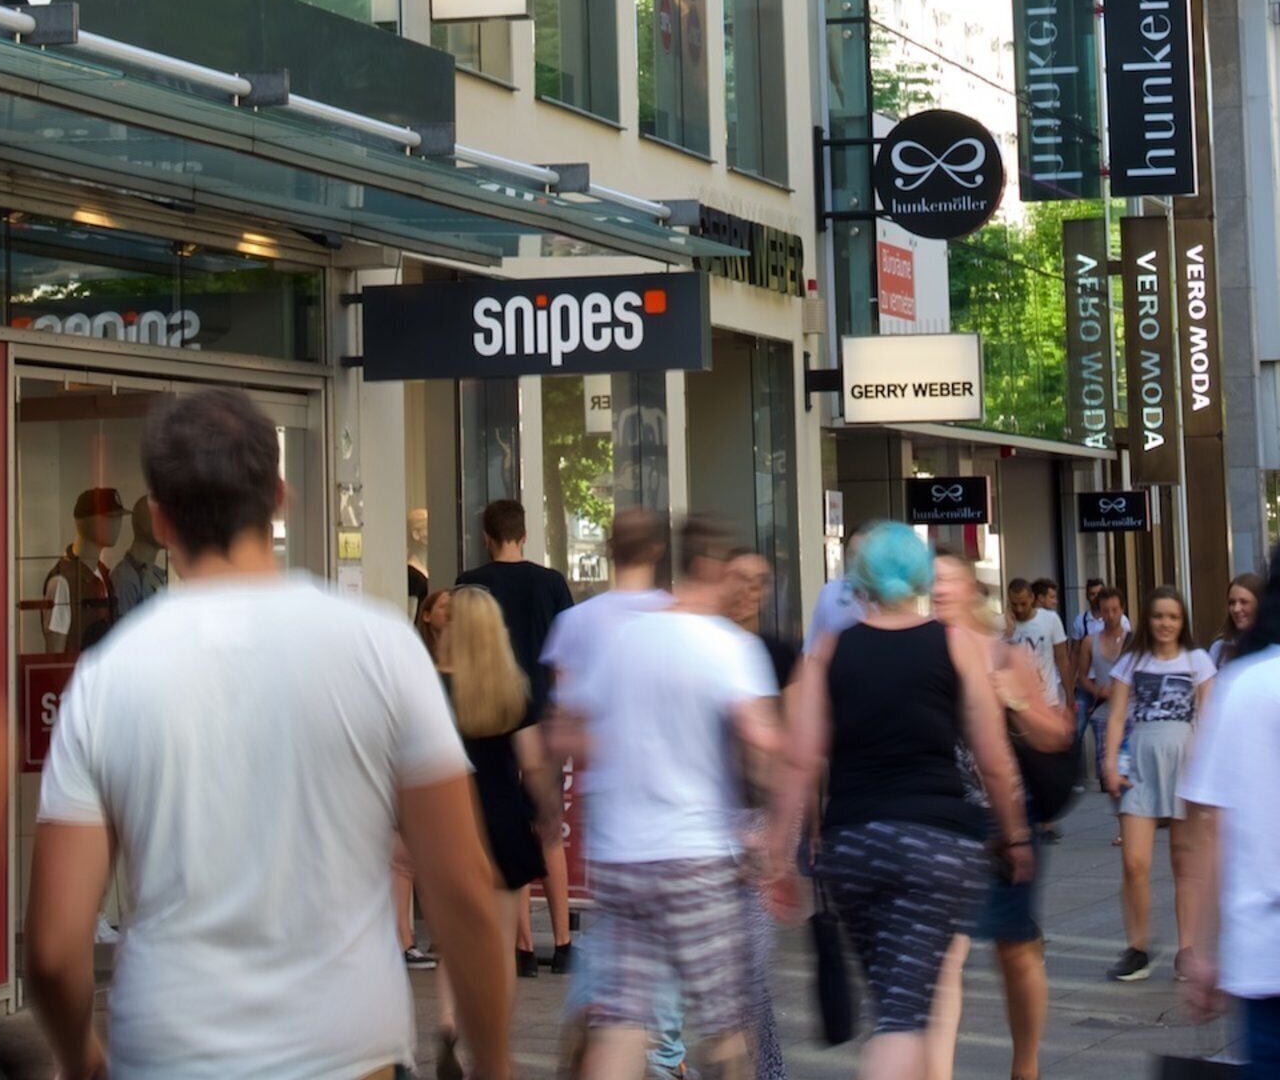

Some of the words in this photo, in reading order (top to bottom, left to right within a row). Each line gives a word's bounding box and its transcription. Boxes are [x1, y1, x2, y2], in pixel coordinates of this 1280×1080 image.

[1136, 250, 1161, 341] VERO
[1185, 244, 1208, 320] VERO
[472, 289, 644, 367] snipes
[1189, 325, 1212, 412] MODA
[850, 383, 909, 400] GERRY
[912, 382, 975, 398] WEBER
[1140, 349, 1166, 452] MODA
